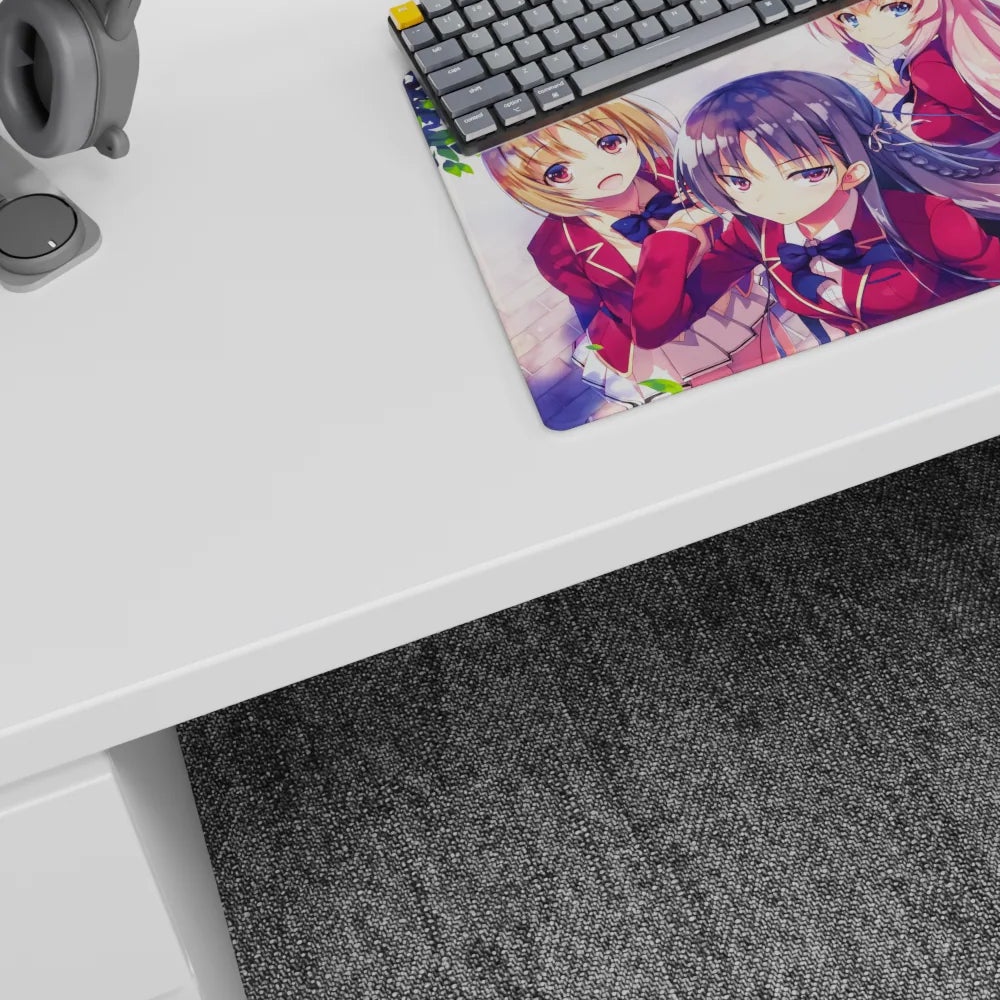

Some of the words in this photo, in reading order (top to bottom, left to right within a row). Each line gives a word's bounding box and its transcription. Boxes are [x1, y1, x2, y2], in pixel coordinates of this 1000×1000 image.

[537, 80, 565, 95] command
[503, 97, 522, 109] option
[463, 111, 484, 124] control
